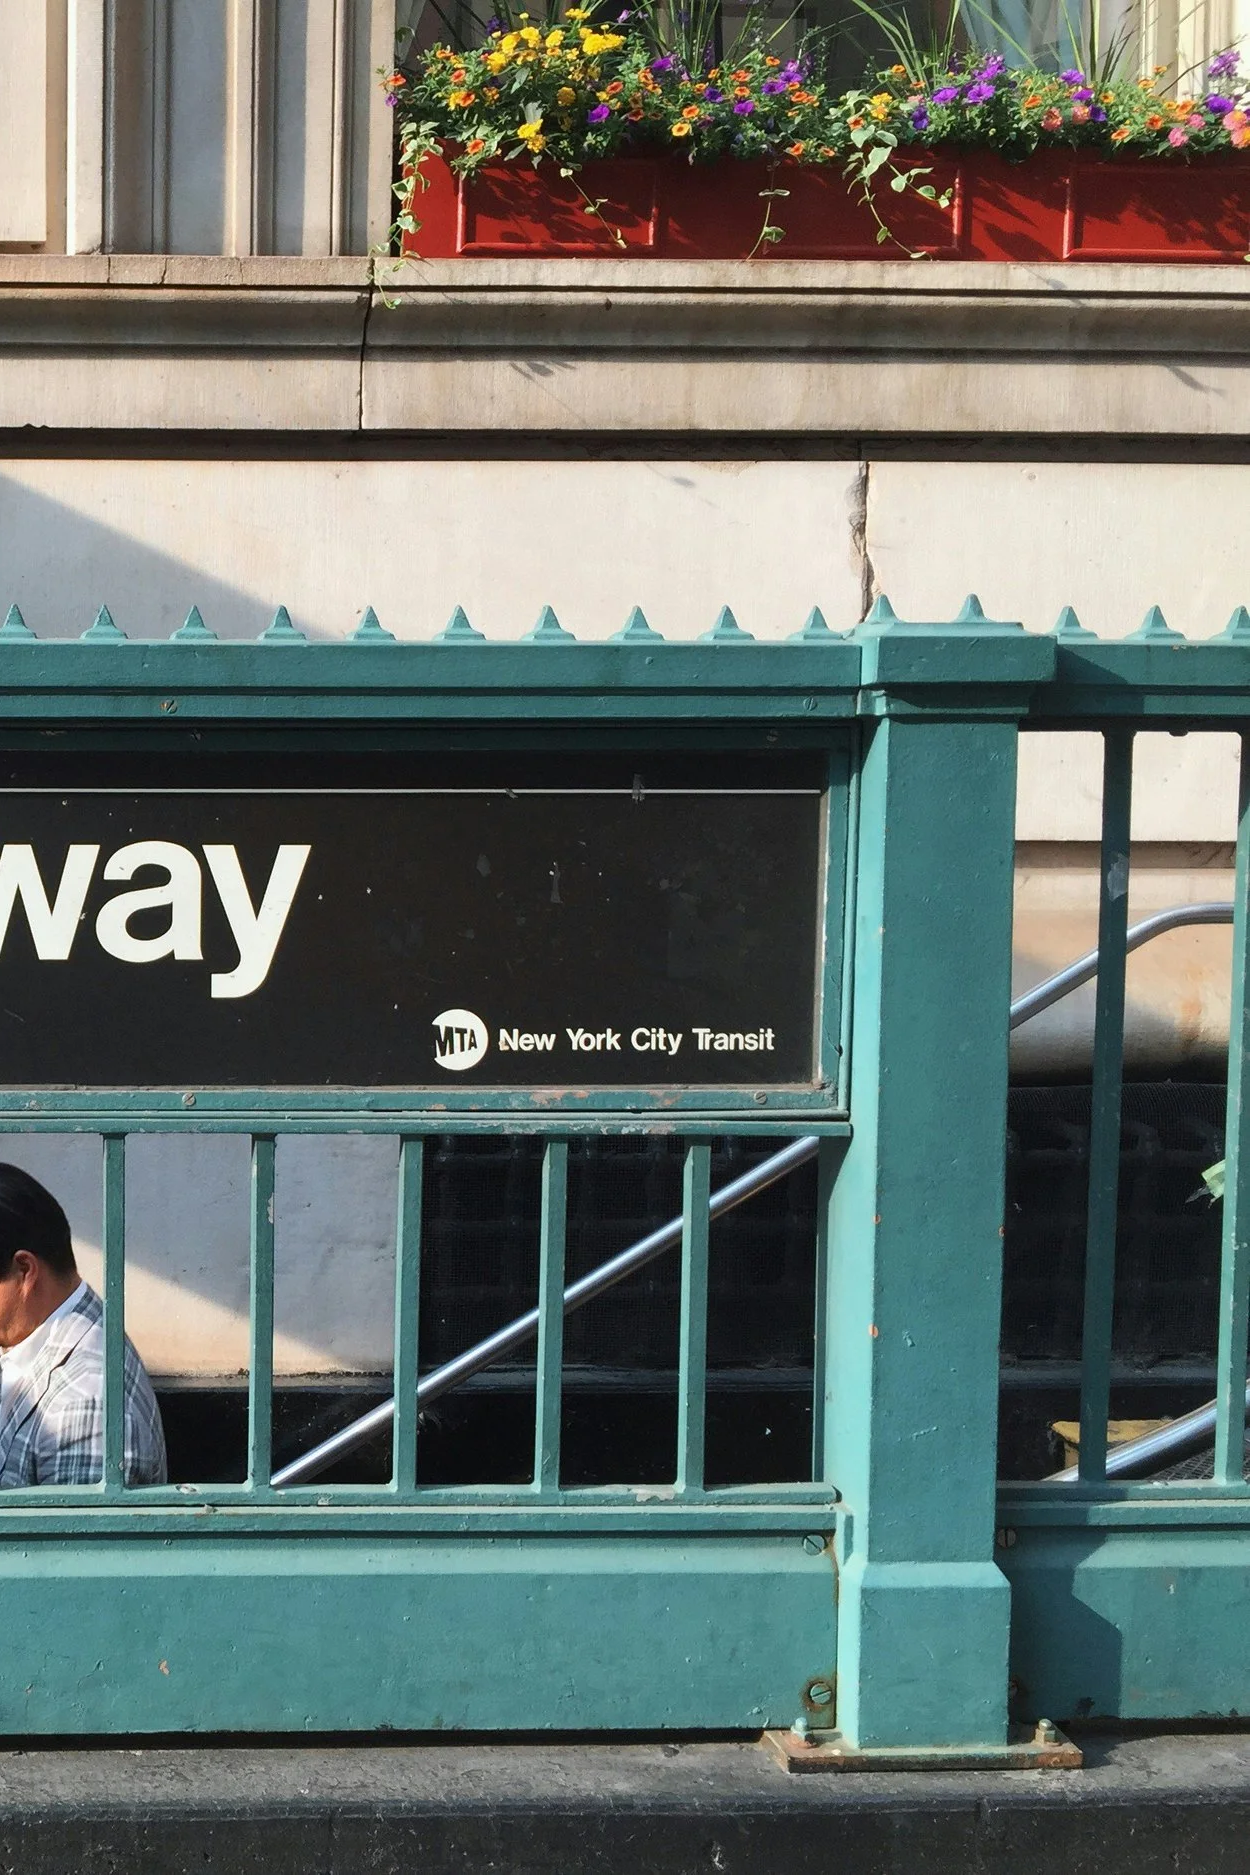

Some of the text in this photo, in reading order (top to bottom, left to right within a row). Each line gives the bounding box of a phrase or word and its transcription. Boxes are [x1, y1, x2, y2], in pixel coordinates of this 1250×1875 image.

[433, 1024, 776, 1059] MTA New York City Transit
